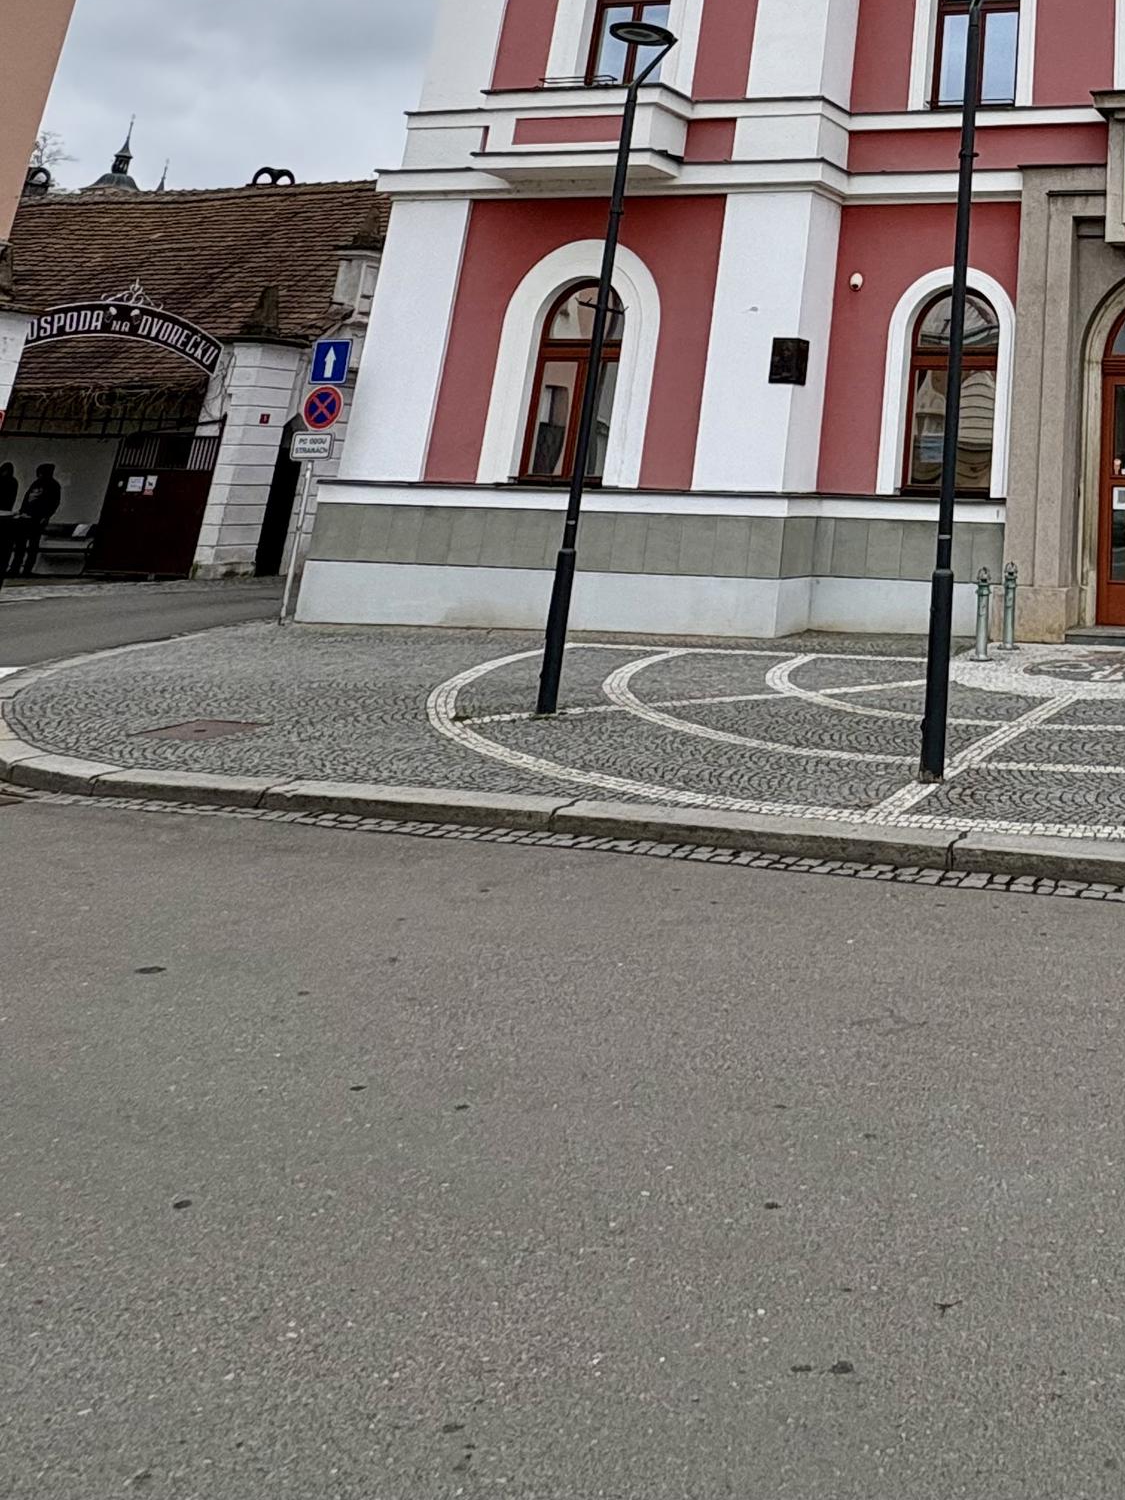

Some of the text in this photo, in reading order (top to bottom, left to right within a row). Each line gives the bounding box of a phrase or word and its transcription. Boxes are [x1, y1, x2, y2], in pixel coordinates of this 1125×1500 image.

[26, 309, 219, 367] OSPODA NA DVOREČKU
